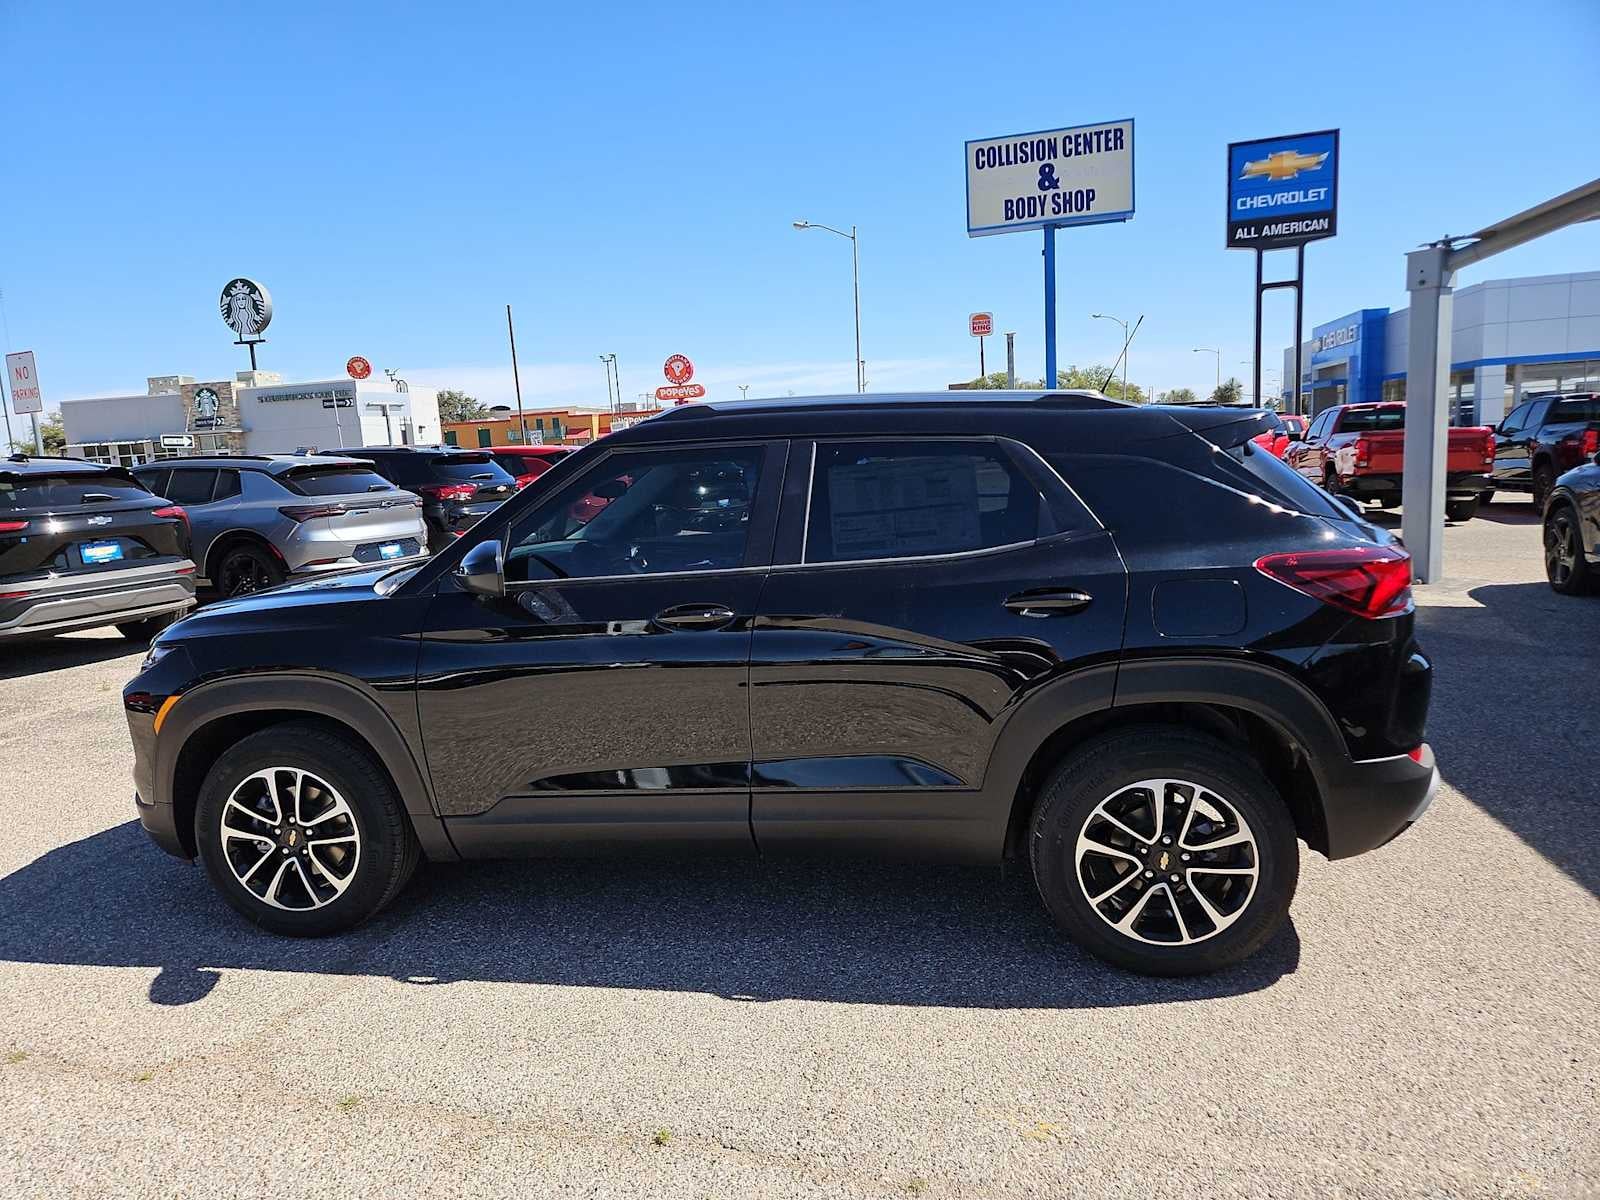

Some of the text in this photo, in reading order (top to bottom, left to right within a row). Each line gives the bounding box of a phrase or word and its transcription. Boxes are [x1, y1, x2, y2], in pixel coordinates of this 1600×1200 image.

[975, 127, 1124, 170] COLLISION CENTER
[1037, 163, 1060, 191] &
[1004, 188, 1096, 221] BODY SHOP
[1236, 187, 1329, 210] CHEVROLET
[1234, 218, 1329, 240] ALL AMERICAN
[15, 366, 29, 380] NO
[12, 387, 40, 400] PARKING
